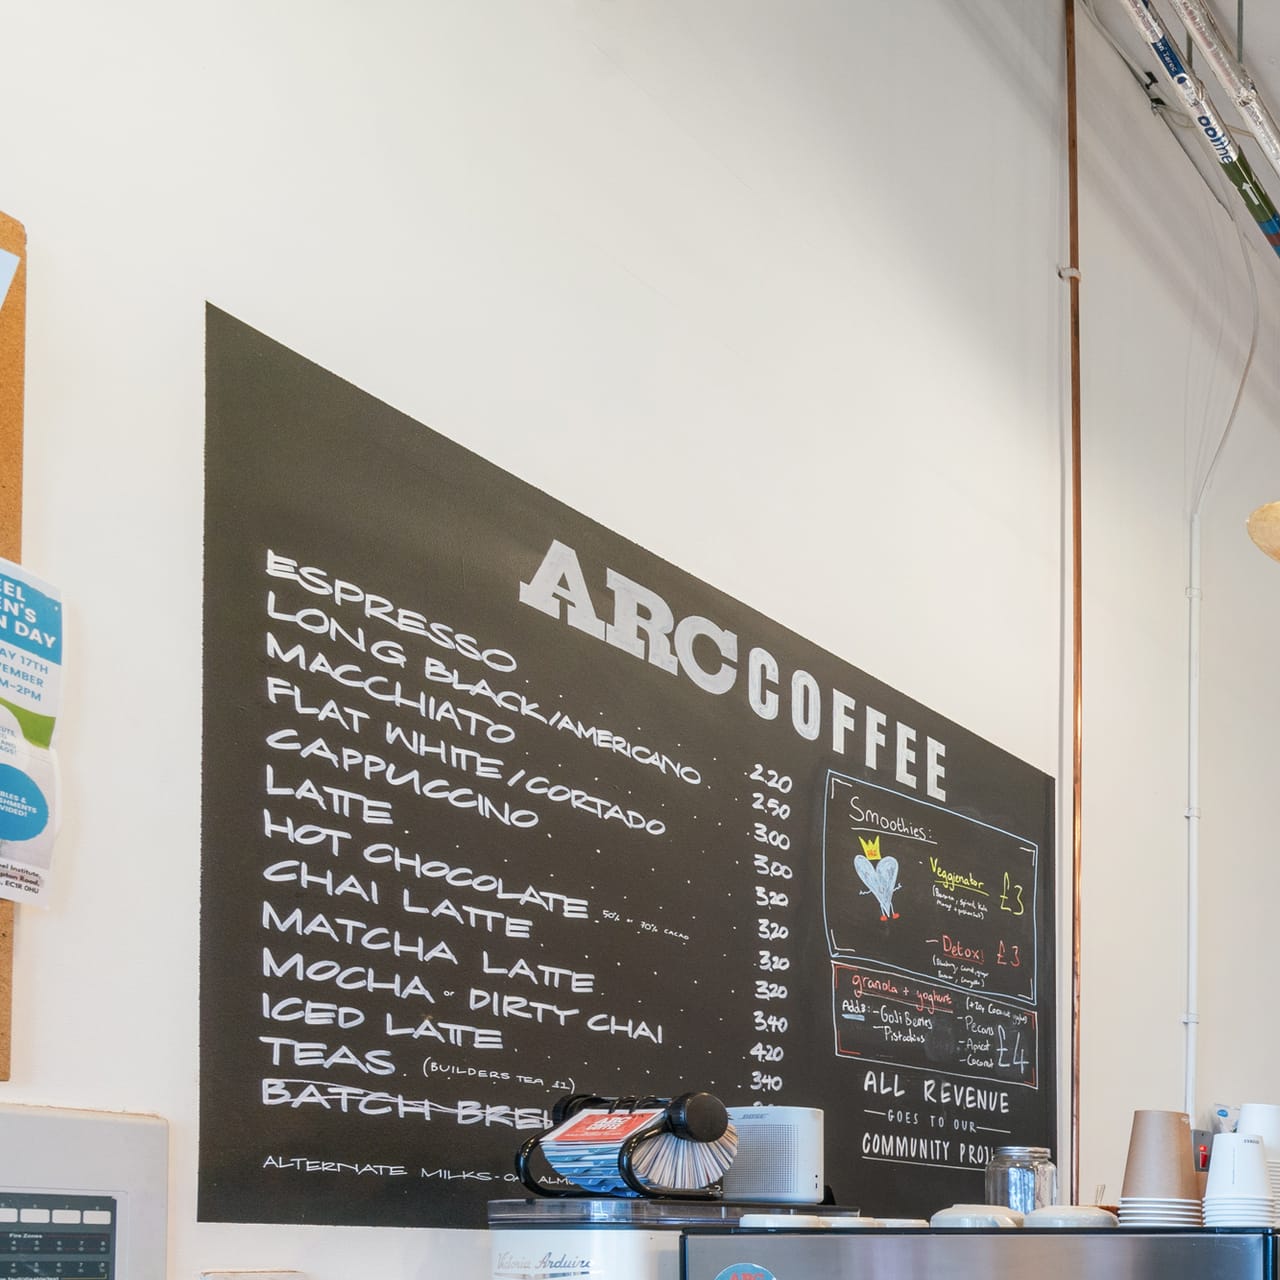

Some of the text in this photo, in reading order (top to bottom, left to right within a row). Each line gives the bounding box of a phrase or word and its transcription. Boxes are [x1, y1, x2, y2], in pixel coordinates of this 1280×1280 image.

[266, 548, 518, 673] ESPRESSO
[14, 619, 58, 650] DAY
[267, 590, 407, 669] LONG
[20, 654, 50, 676] 17TH
[518, 538, 948, 803] ARC COFFEE
[266, 632, 516, 745] MACCHIATO
[266, 676, 371, 734] FLAT
[385, 719, 505, 779] WHITE
[266, 728, 540, 829] CAPPUCCINO
[749, 762, 794, 794] 2.20
[266, 764, 394, 827] LATTE
[750, 792, 791, 821] 2.50
[753, 826, 792, 851] 3.00
[262, 807, 353, 857] HOT
[363, 842, 590, 919] CHOCOLATE
[751, 854, 793, 881] 3.00
[262, 859, 534, 940] CHAI LATTE
[755, 885, 790, 910] 3.20
[757, 917, 790, 942] 3.20
[261, 900, 597, 994] MATCHA LATTE
[758, 949, 791, 973] 3.20
[261, 947, 436, 1004] MOCHA
[468, 988, 581, 1026] DIRTY
[586, 1012, 664, 1045] CHAI
[754, 979, 789, 1001] 3.20
[852, 973, 899, 998] granola
[261, 991, 505, 1050] ICED LATTE
[752, 1009, 789, 1034] 3.40
[257, 1034, 397, 1077] TEAS
[749, 1041, 785, 1064] 4.20
[750, 1070, 784, 1093] 3.40
[862, 1069, 1011, 1115] ALL REVENUE
[261, 1077, 432, 1122] BATCH
[886, 1108, 978, 1134] GOES TO OUR
[861, 1131, 951, 1162] COMMUNITY
[262, 1154, 409, 1177] ALTERNATE
